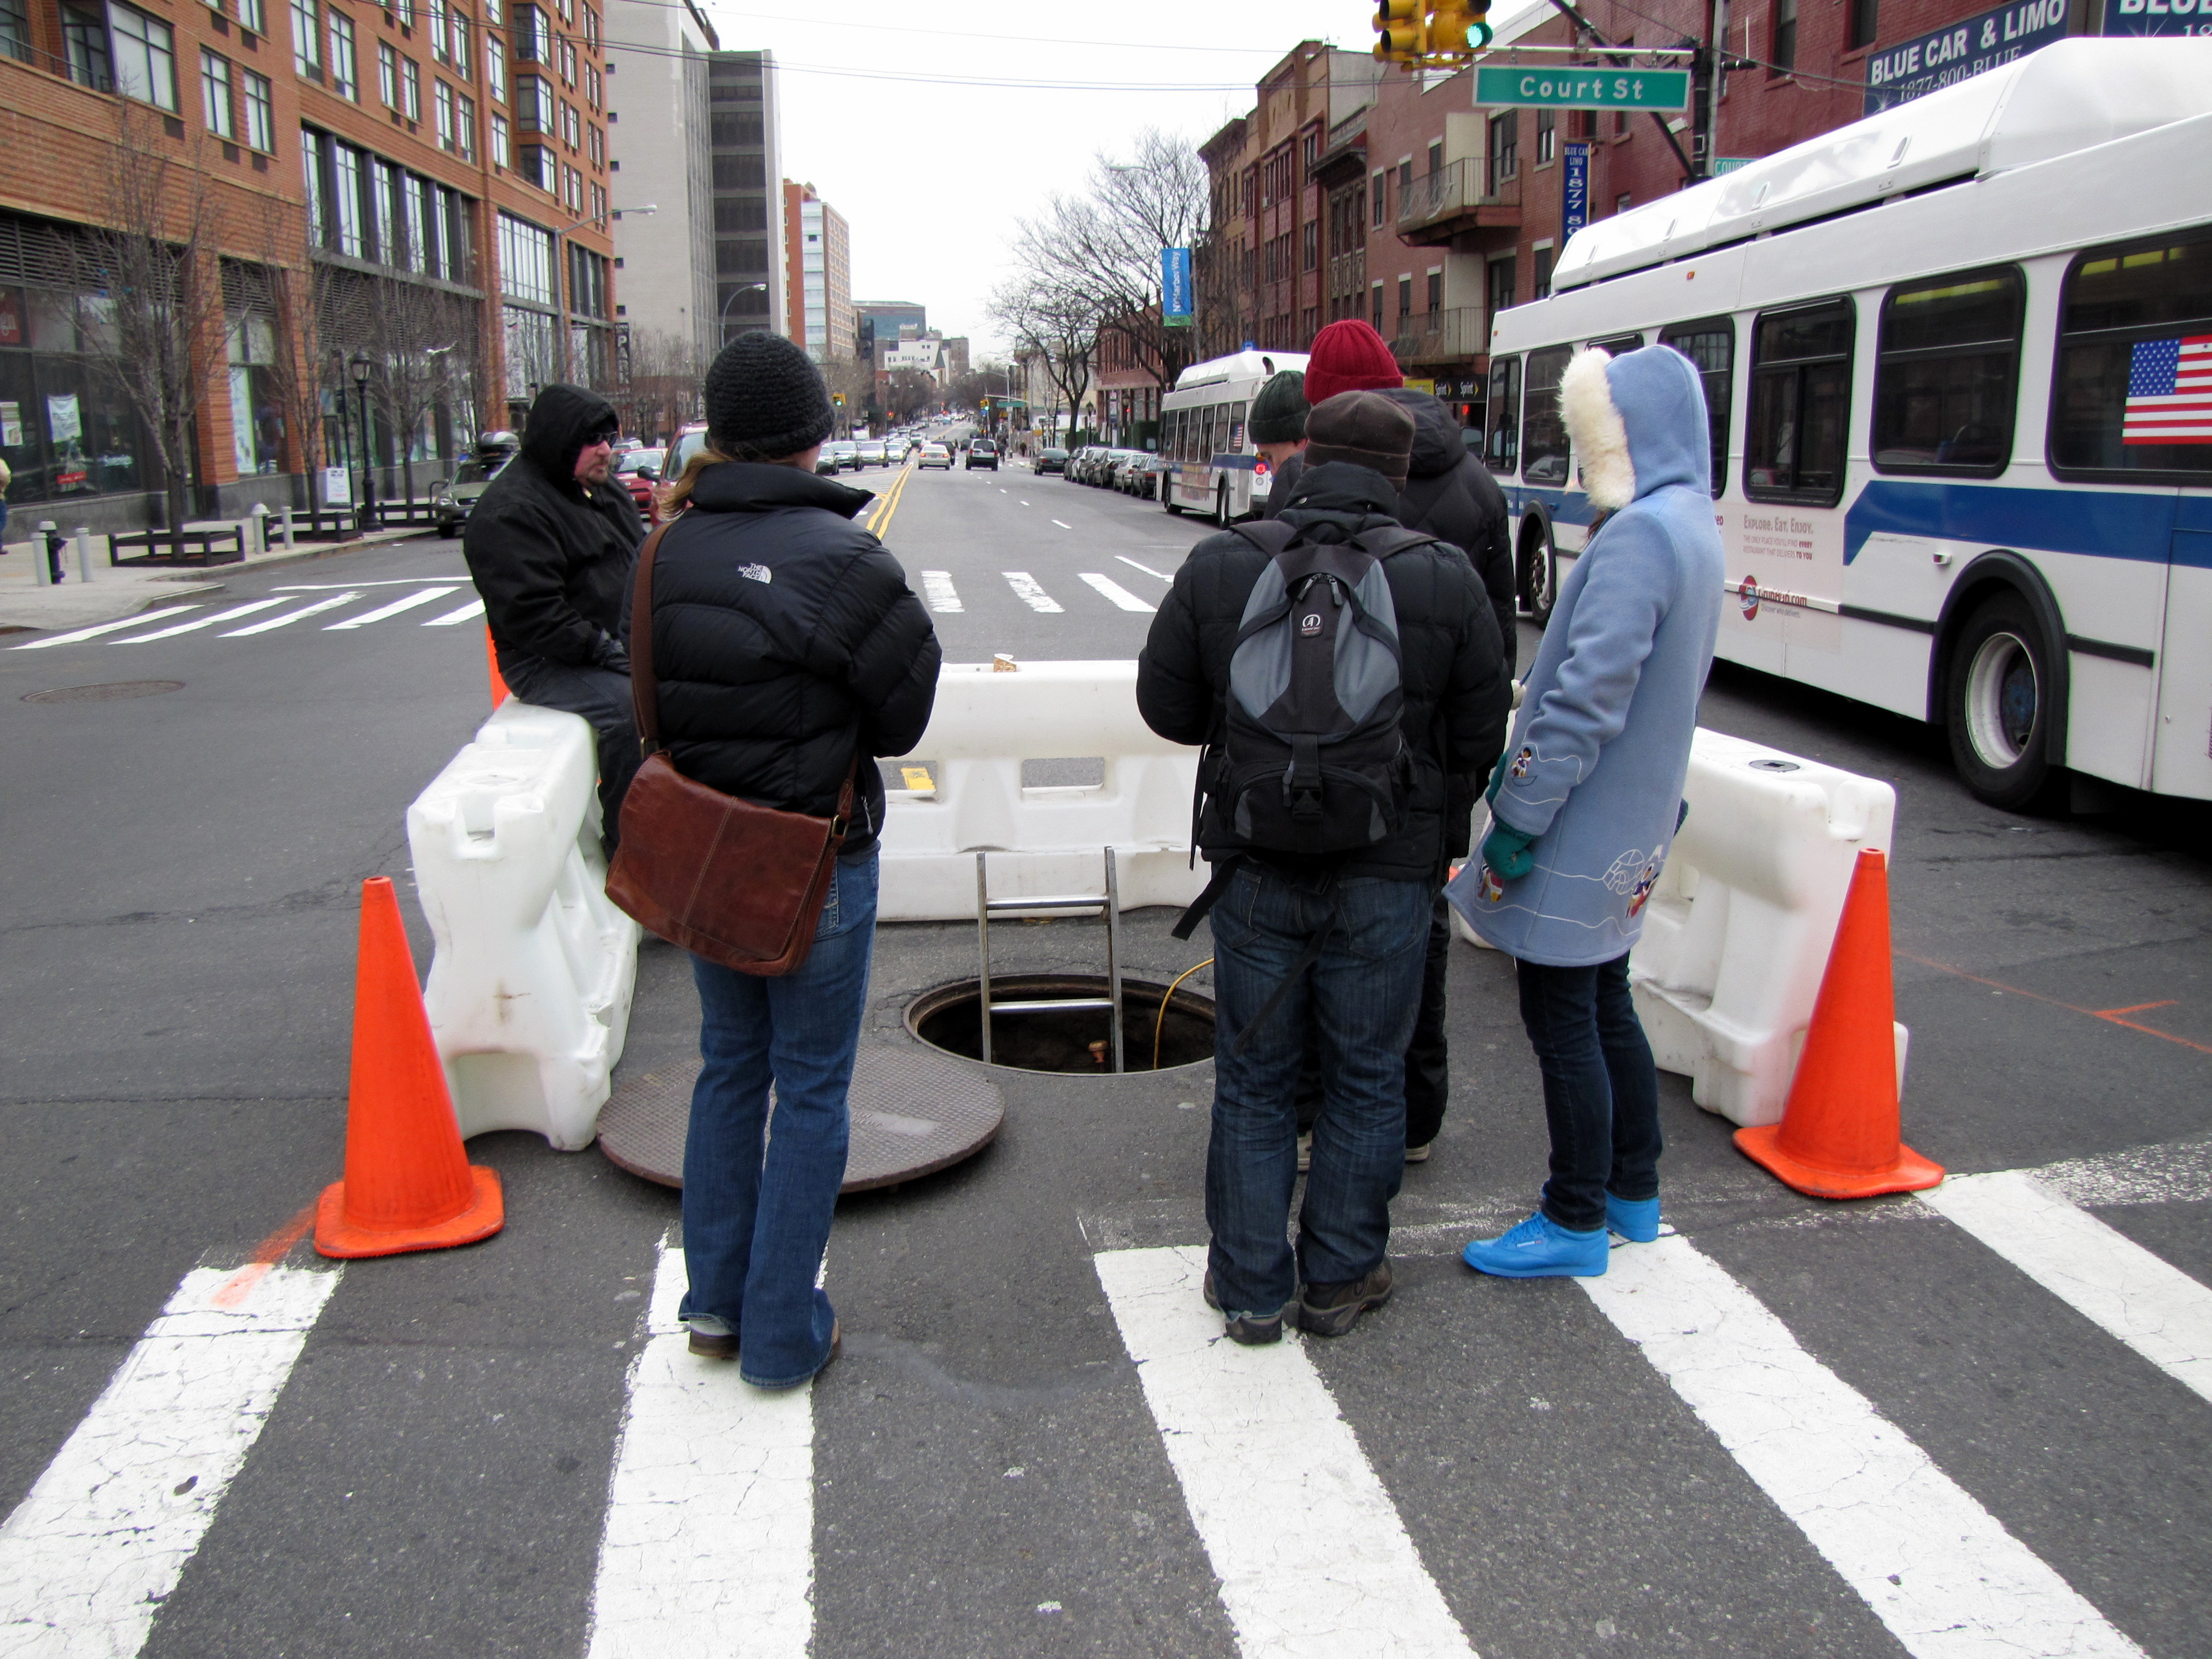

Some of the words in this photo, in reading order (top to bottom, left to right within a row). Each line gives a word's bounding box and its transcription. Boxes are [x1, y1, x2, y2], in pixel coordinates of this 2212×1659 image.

[1870, 45, 1921, 86] BLUE
[1925, 28, 1969, 67] CAR
[1980, 18, 1997, 49] &
[2003, 0, 2066, 41] LIMO
[1520, 76, 1603, 98] Court
[1613, 77, 1644, 100] St
[1564, 146, 1577, 156] BLUE
[1569, 156, 1583, 166] LIMO
[1715, 160, 1747, 176] COUR
[738, 565, 762, 576] NORTH
[742, 571, 760, 581] FACE
